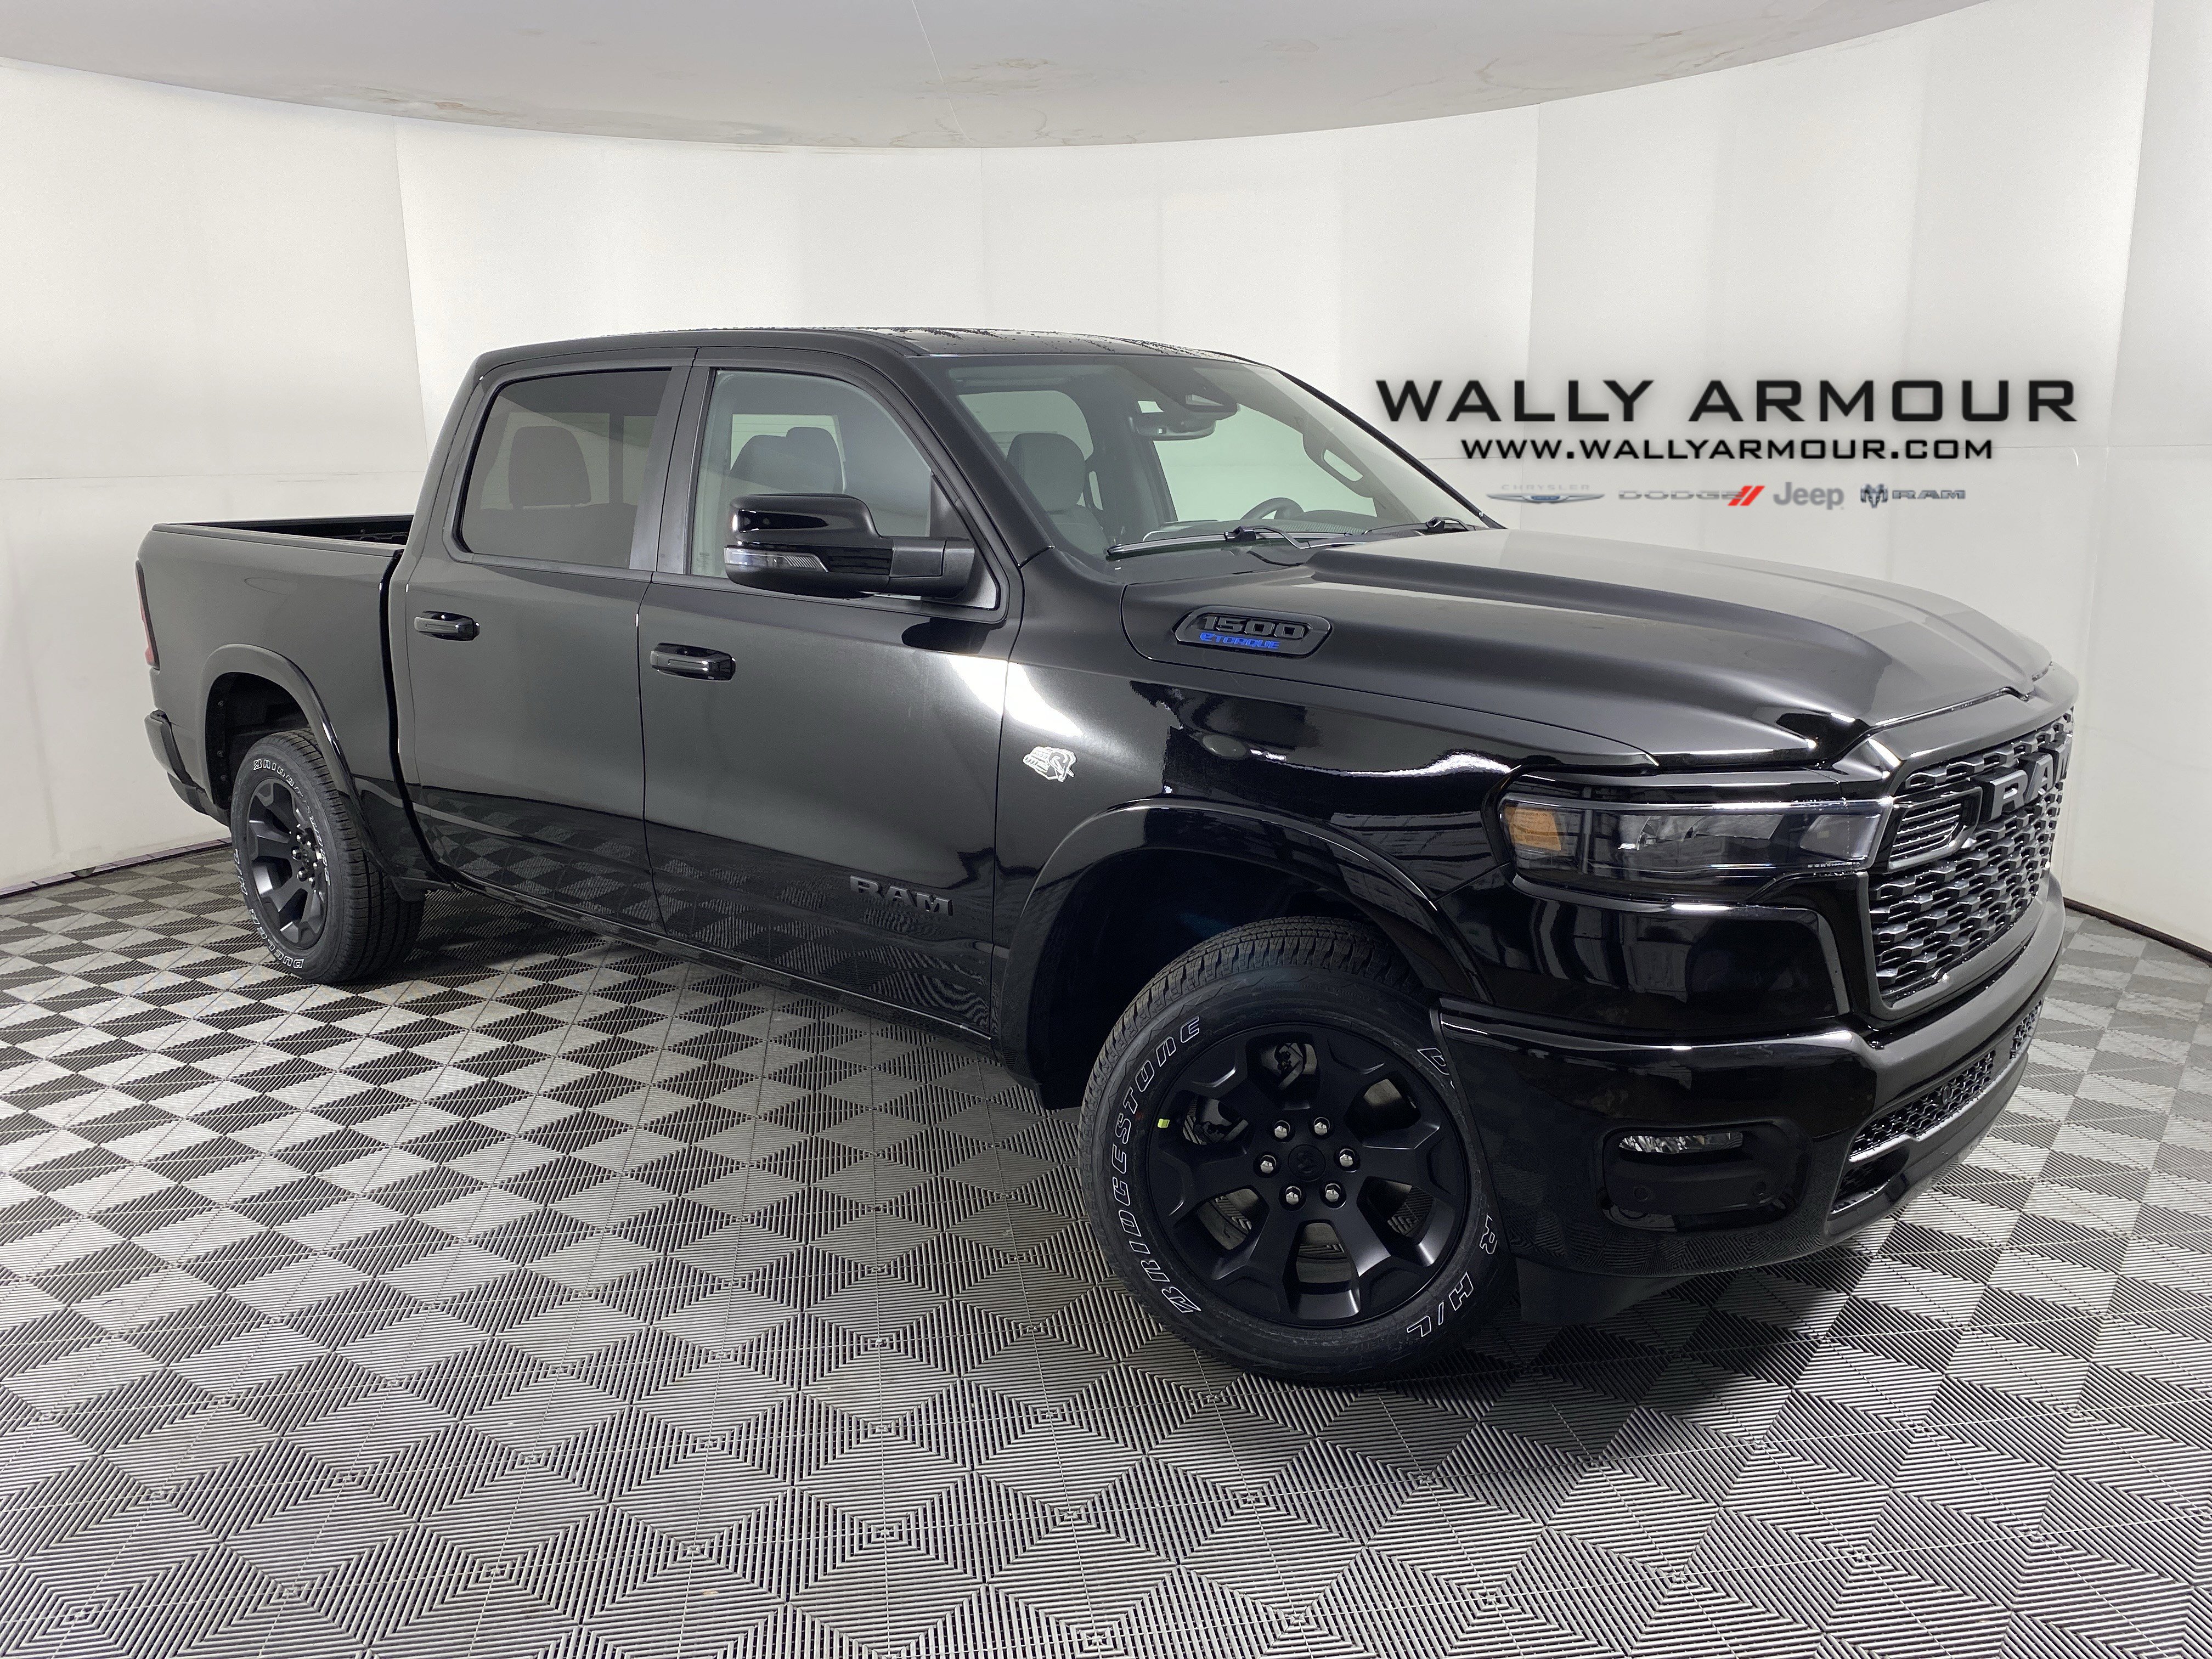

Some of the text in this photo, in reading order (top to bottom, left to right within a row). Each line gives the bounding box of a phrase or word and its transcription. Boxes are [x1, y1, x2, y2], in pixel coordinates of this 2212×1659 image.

[1202, 615, 1305, 640] 1500
[850, 875, 954, 916] RAM
[249, 908, 304, 969] DUELER
[1110, 1015, 1202, 1314] BRIDGESTONE
[1406, 1272, 1474, 1338] H/L
